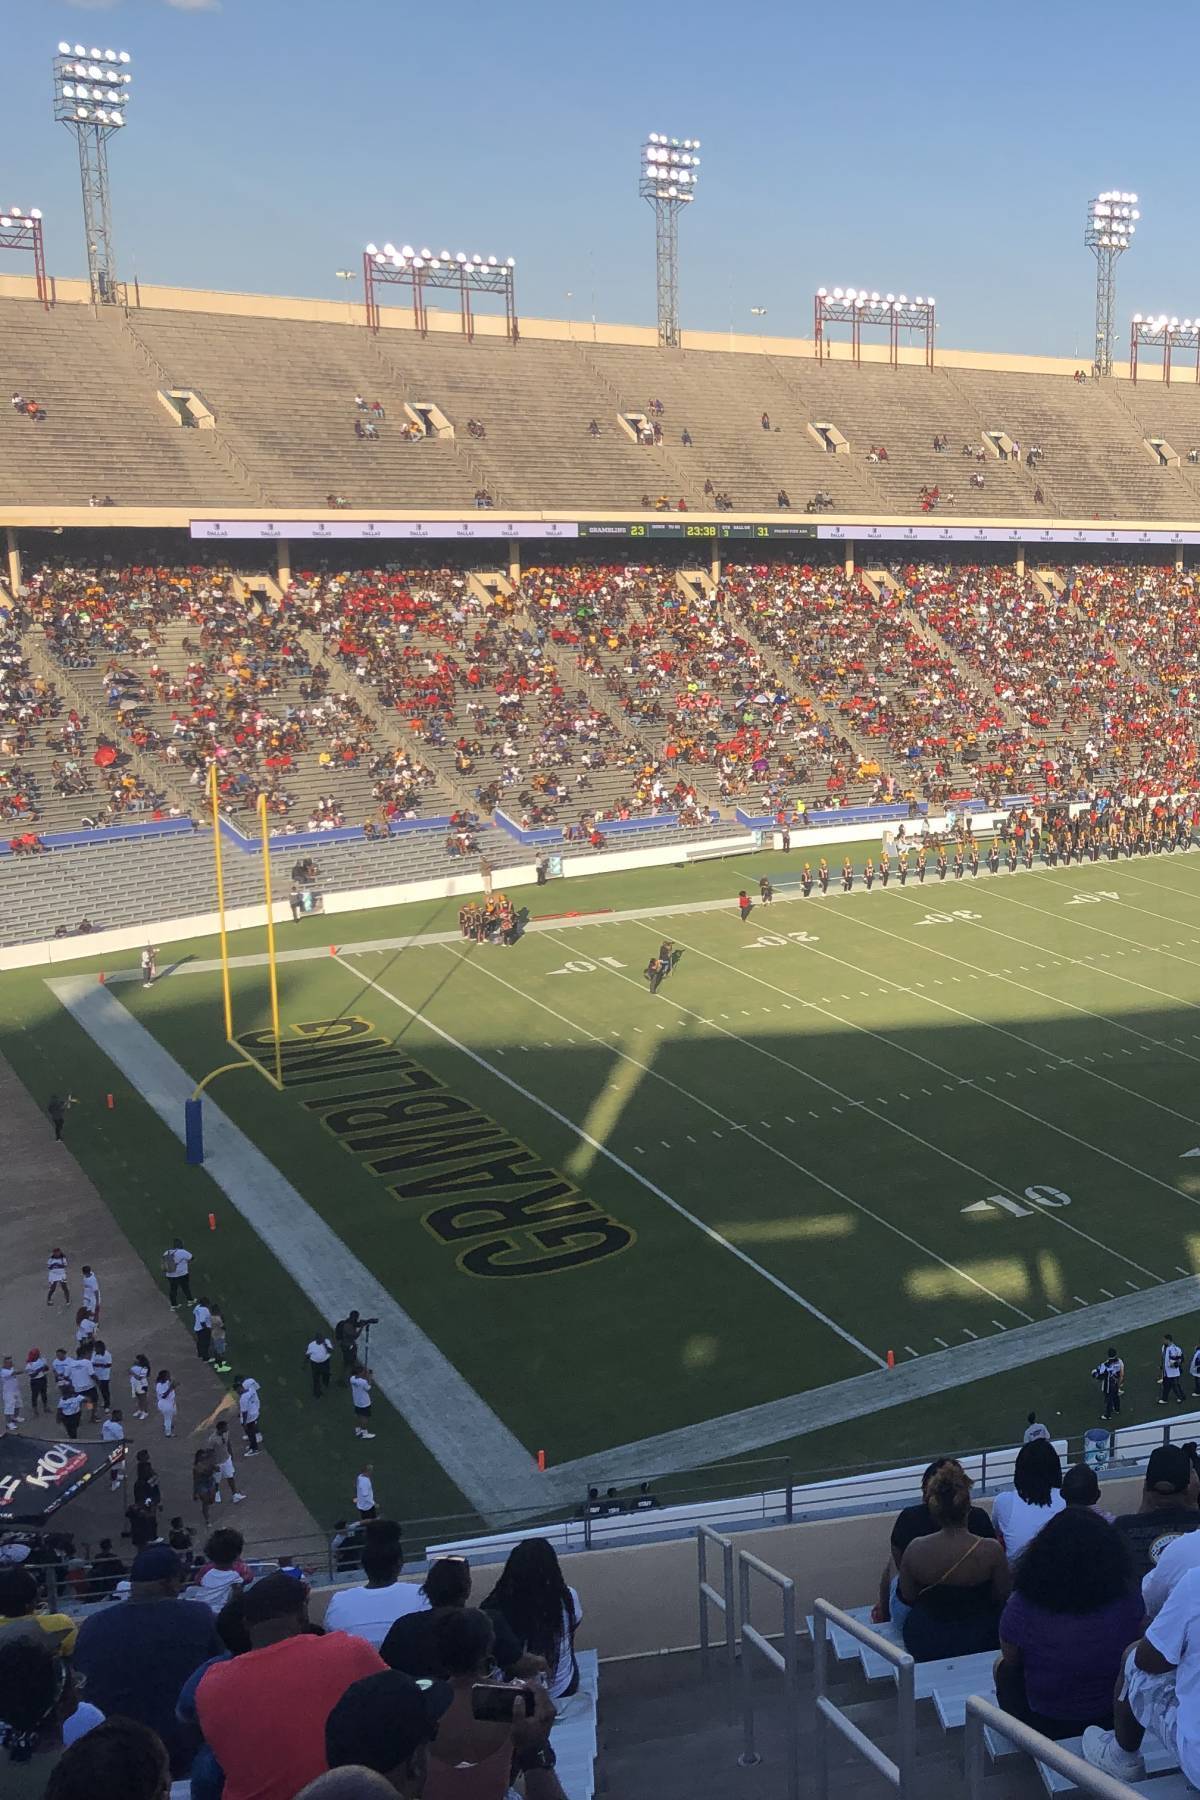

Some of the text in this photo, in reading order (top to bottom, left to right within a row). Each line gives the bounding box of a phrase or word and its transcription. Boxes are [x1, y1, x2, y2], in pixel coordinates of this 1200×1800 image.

[630, 526, 644, 535] 23
[687, 526, 716, 536] 23:38
[757, 527, 769, 536] 31
[925, 910, 983, 925] 30
[757, 931, 820, 947] 20
[236, 1015, 638, 1279] GRAMBLING
[987, 1184, 1072, 1219] 10
